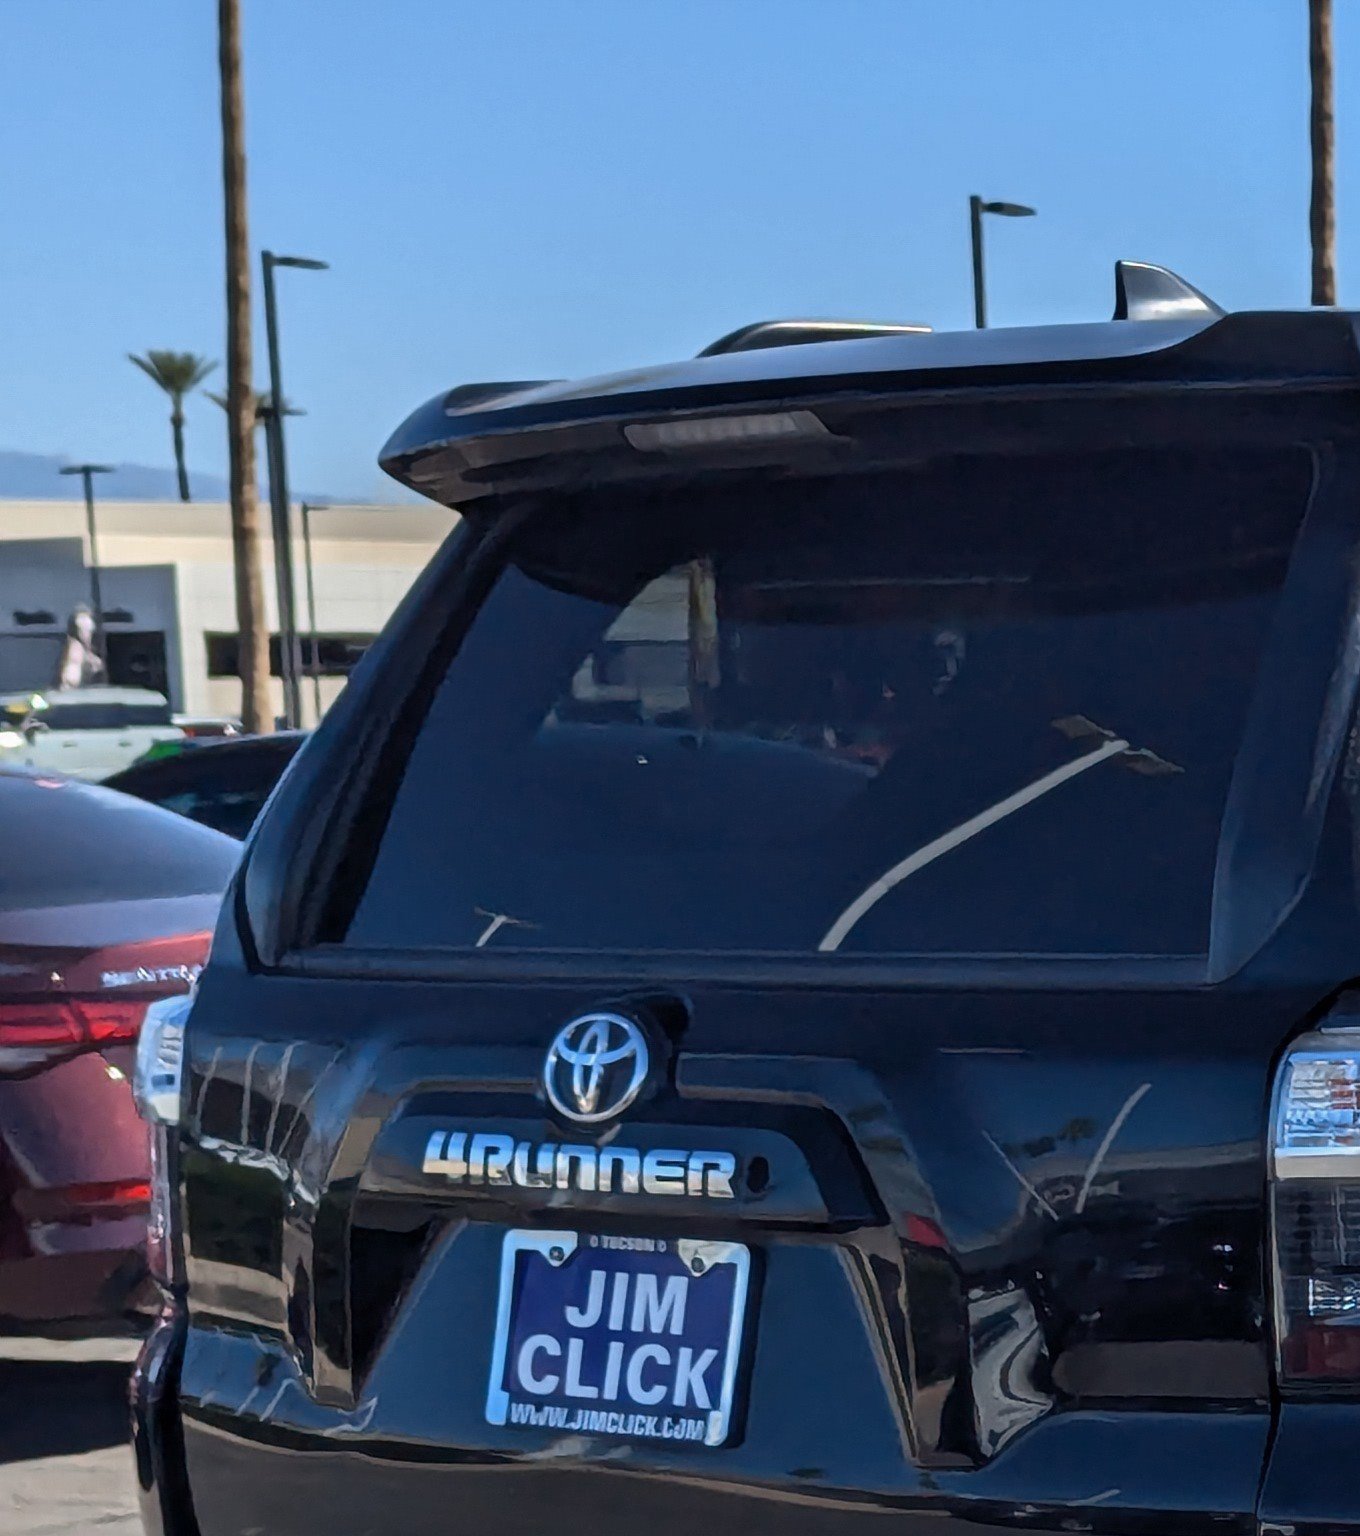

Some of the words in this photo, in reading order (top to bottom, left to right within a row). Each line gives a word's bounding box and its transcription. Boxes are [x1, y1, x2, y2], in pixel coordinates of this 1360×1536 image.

[421, 1130, 737, 1199] 4RUNNER
[565, 1269, 689, 1336] JIM
[516, 1333, 720, 1410] CLICK
[510, 1402, 706, 1441] WWW.JIMCLICK.COM
